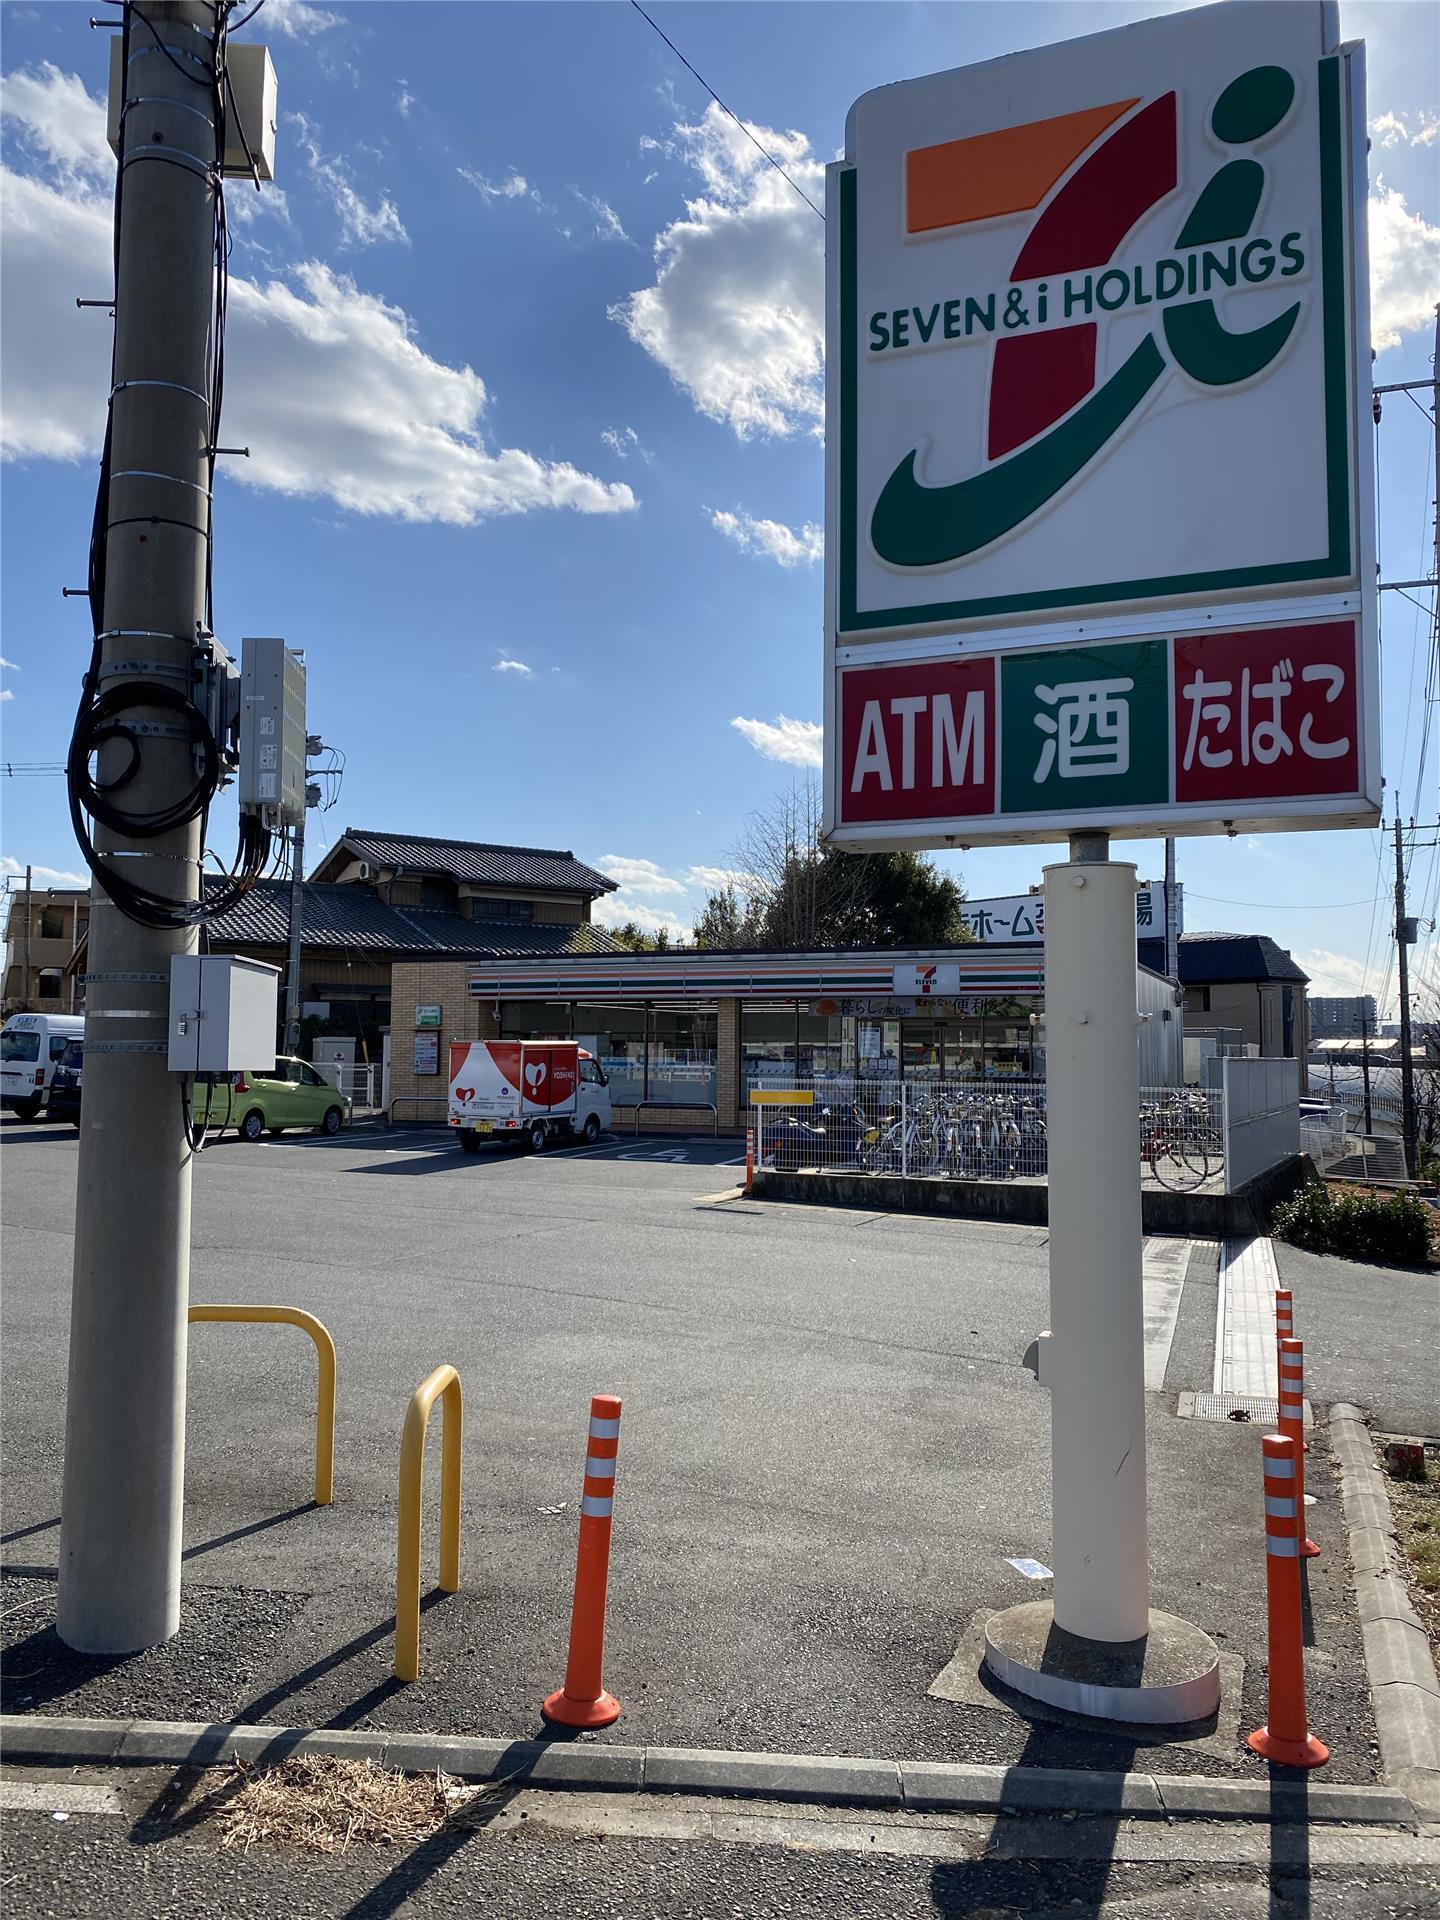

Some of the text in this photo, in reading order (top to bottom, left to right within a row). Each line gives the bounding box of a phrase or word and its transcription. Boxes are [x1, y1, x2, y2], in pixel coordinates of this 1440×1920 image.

[1063, 232, 1305, 318] HOLDINGS
[850, 690, 985, 793] ATM
[1033, 677, 1135, 783] 酒
[1183, 658, 1350, 771] たばこ
